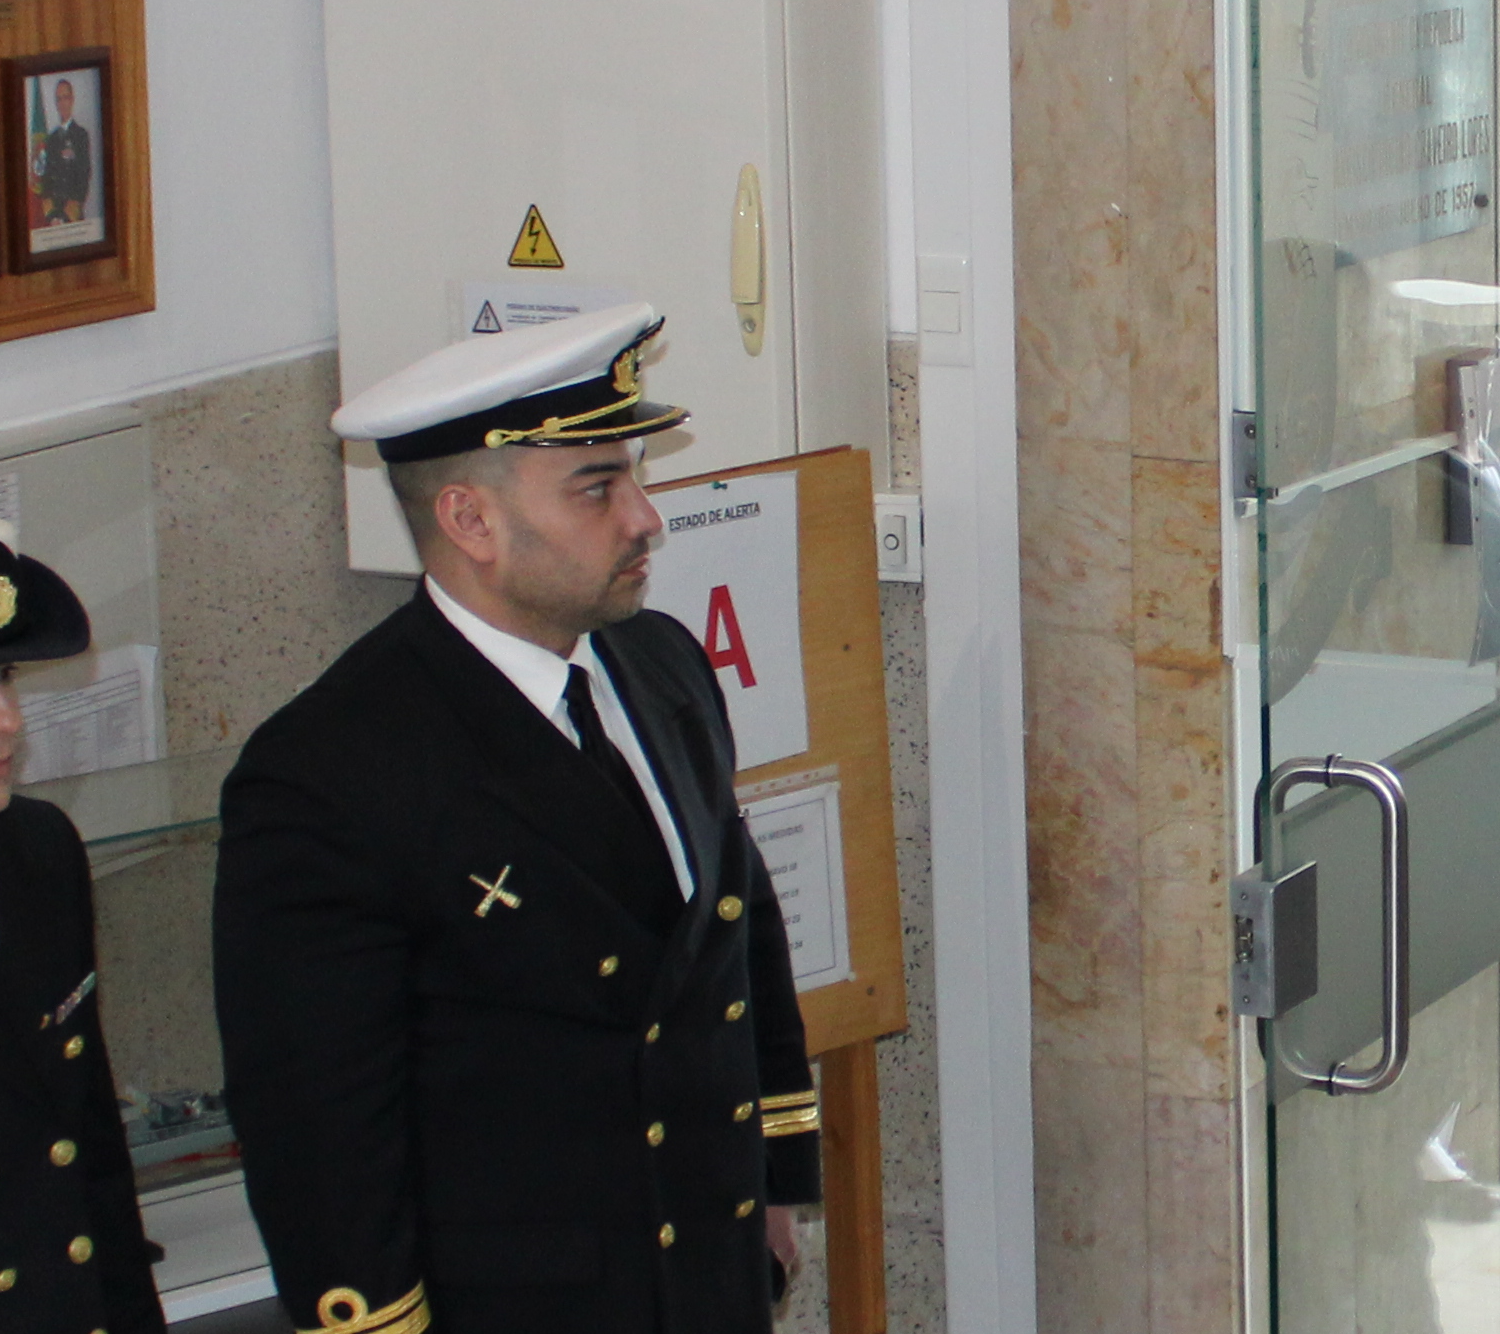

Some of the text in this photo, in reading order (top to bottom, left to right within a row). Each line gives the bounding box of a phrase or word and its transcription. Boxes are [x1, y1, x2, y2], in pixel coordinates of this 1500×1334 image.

[1462, 114, 1490, 158] LOPES
[1434, 189, 1448, 217] DE
[668, 502, 761, 532] ESTADO DE ALERTA
[703, 584, 758, 689] A
